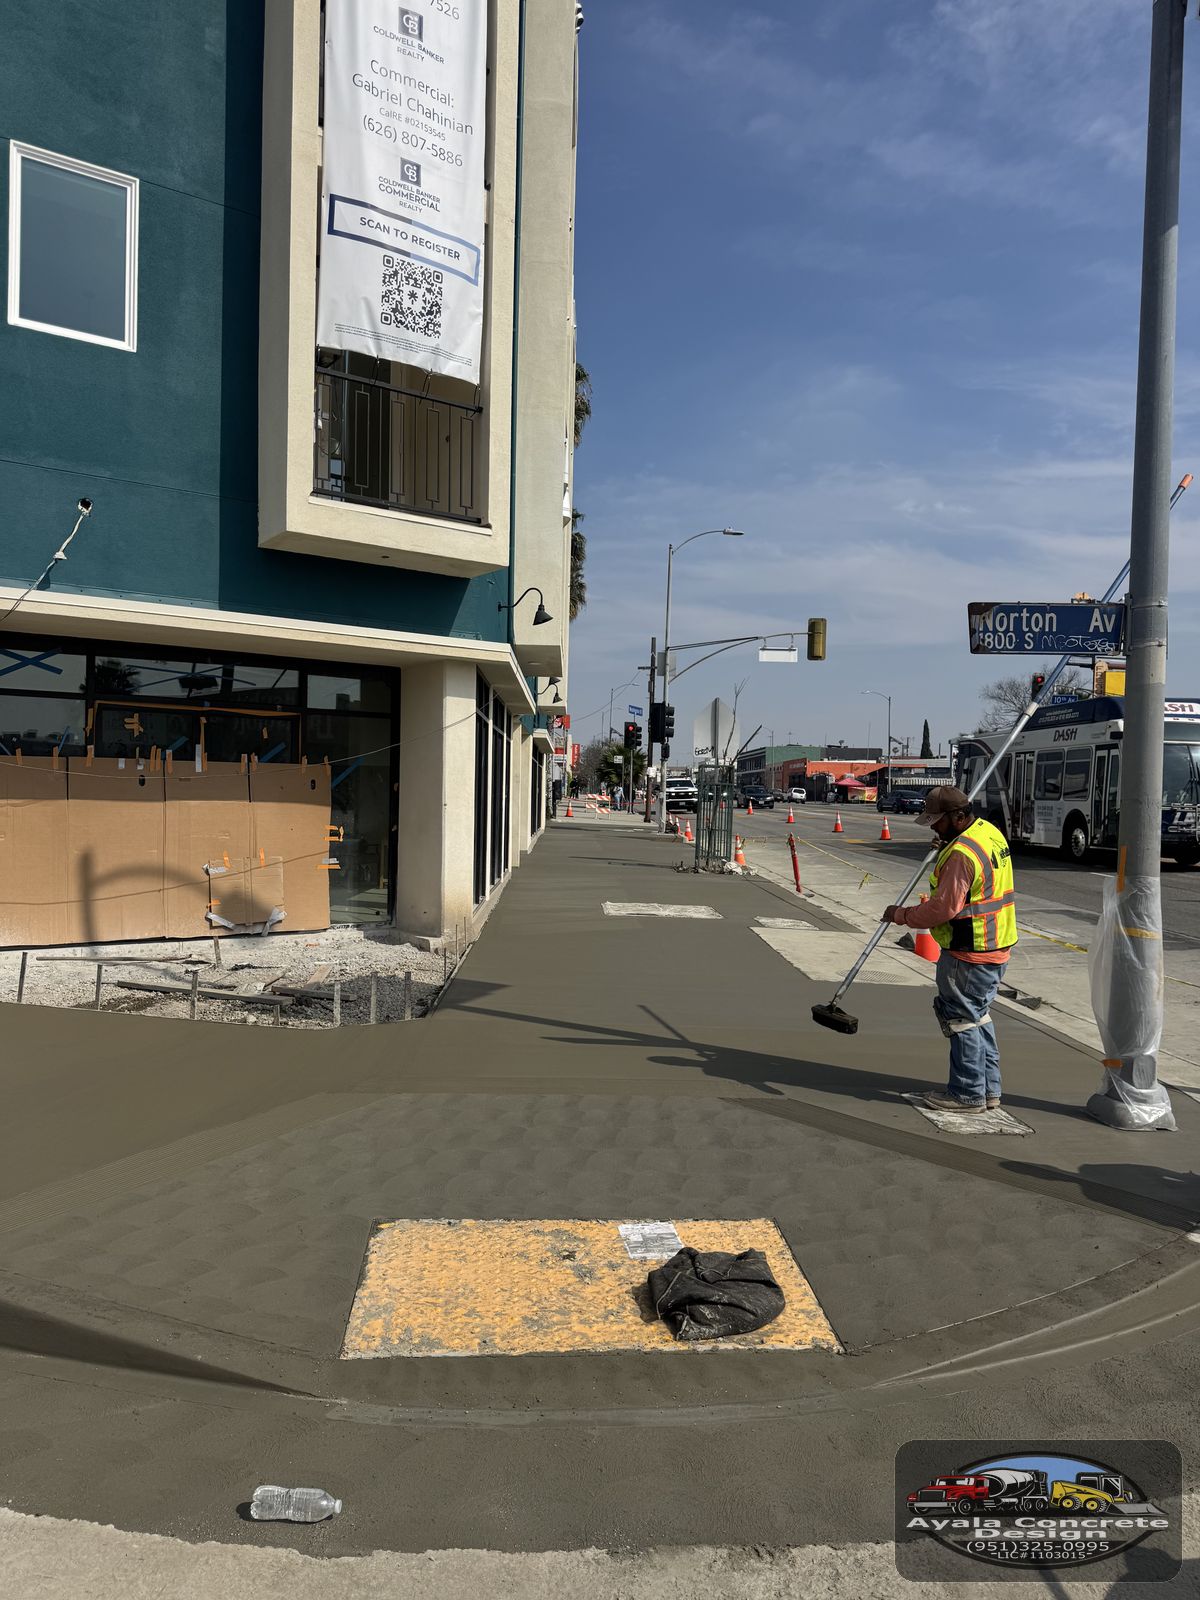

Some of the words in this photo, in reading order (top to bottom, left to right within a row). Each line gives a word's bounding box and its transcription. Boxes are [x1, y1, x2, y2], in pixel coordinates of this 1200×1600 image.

[373, 25, 416, 48] COLDWELL
[417, 43, 445, 64] BANKER
[396, 46, 425, 62] REALTY
[370, 59, 455, 108] Commercial:
[352, 73, 402, 107] Gabriel
[406, 97, 474, 136] Chahinian
[363, 115, 398, 143] (626)
[401, 131, 464, 167] 807-5886
[378, 175, 415, 194] COLDWELL
[415, 188, 441, 204] BANKER
[378, 183, 441, 213] COMMERCIAL
[399, 200, 423, 214] REALTY
[359, 216, 391, 235] SCAN
[393, 227, 409, 241] TO
[411, 234, 461, 261] REGISTER
[978, 607, 1057, 633] Norton
[1088, 608, 1117, 633] Av
[1024, 632, 1034, 650] S
[1164, 703, 1194, 713] SH
[1053, 727, 1078, 742] DASH
